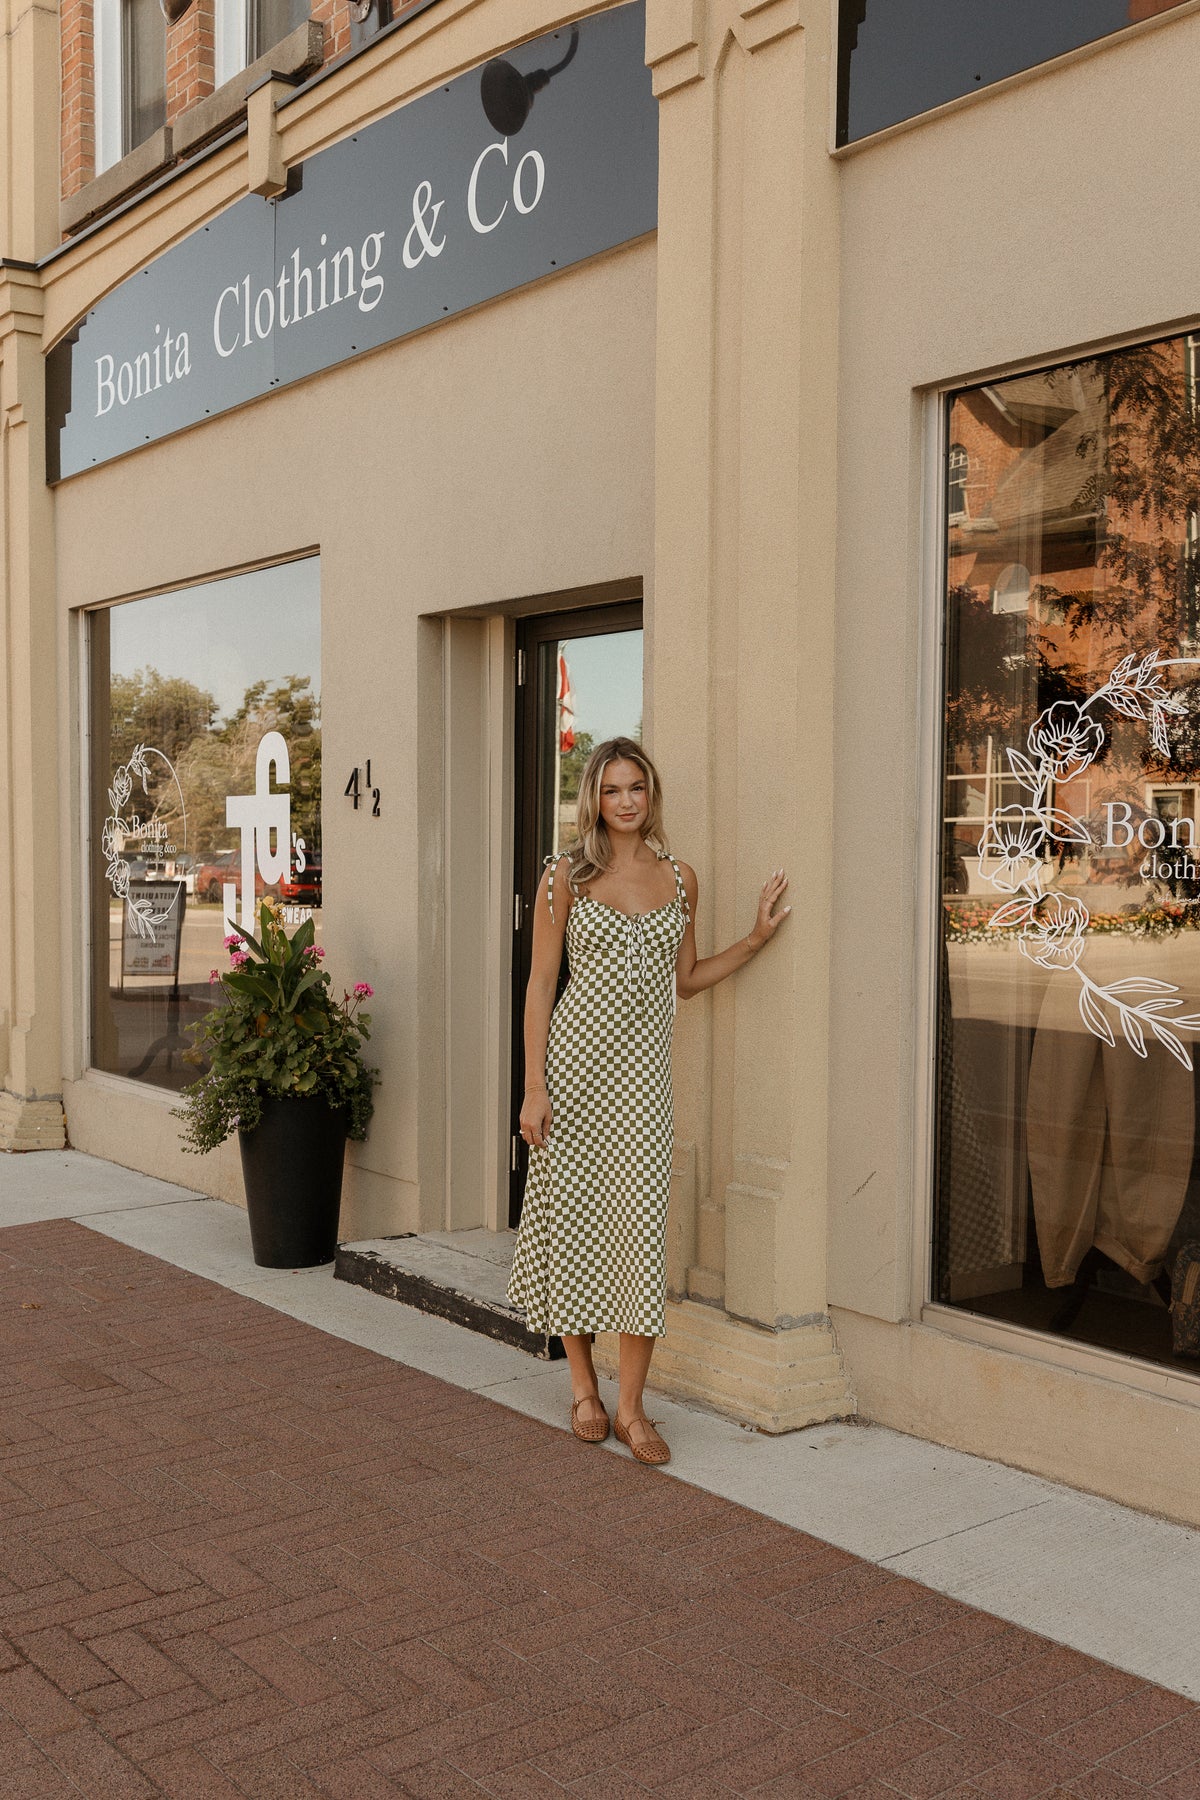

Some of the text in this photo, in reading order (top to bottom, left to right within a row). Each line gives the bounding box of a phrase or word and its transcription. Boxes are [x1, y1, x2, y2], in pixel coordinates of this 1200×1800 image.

[95, 136, 546, 418] Bonita Clothing & Co
[131, 815, 169, 839] Bonita
[1100, 801, 1200, 849] Bon
[1139, 854, 1200, 880] cloth
